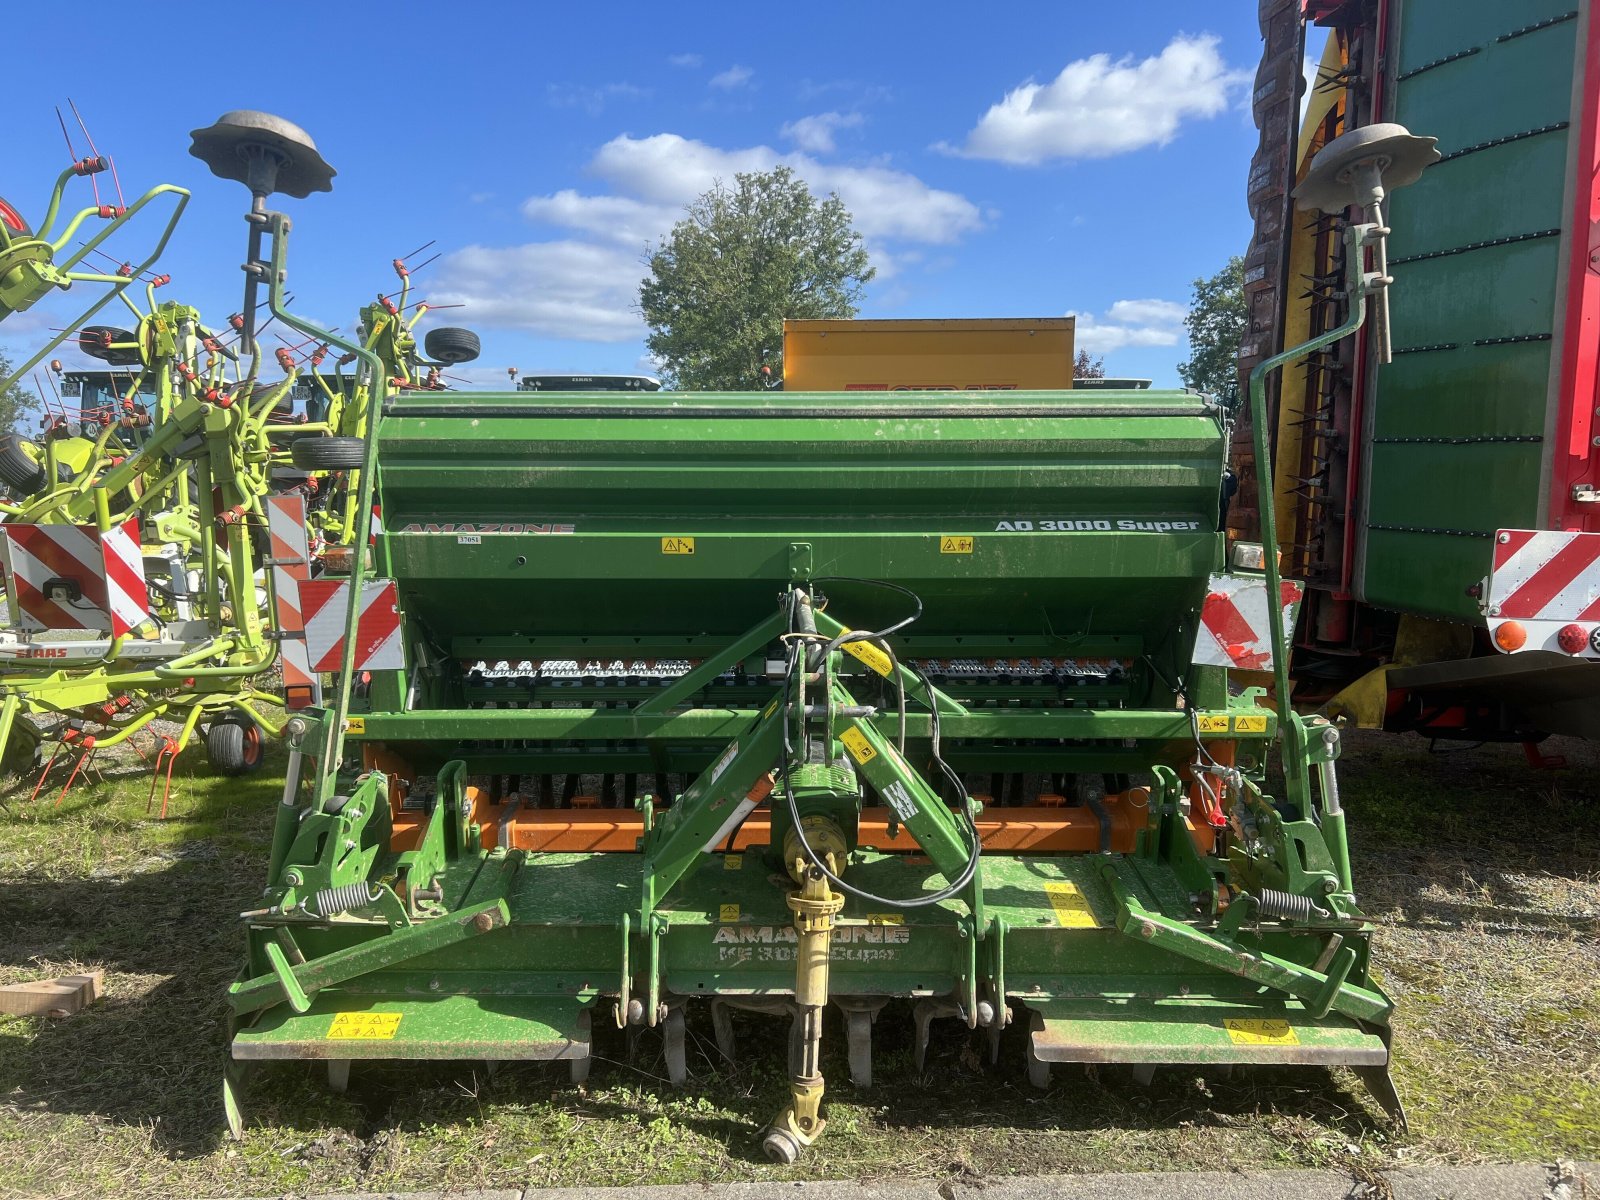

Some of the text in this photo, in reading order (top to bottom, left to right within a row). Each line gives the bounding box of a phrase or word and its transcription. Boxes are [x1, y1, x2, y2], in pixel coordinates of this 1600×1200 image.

[399, 523, 576, 535] AMAZONE
[995, 520, 1200, 532] AD 3000 Super
[16, 648, 67, 659] CLAAS
[712, 926, 910, 944] AMAONE
